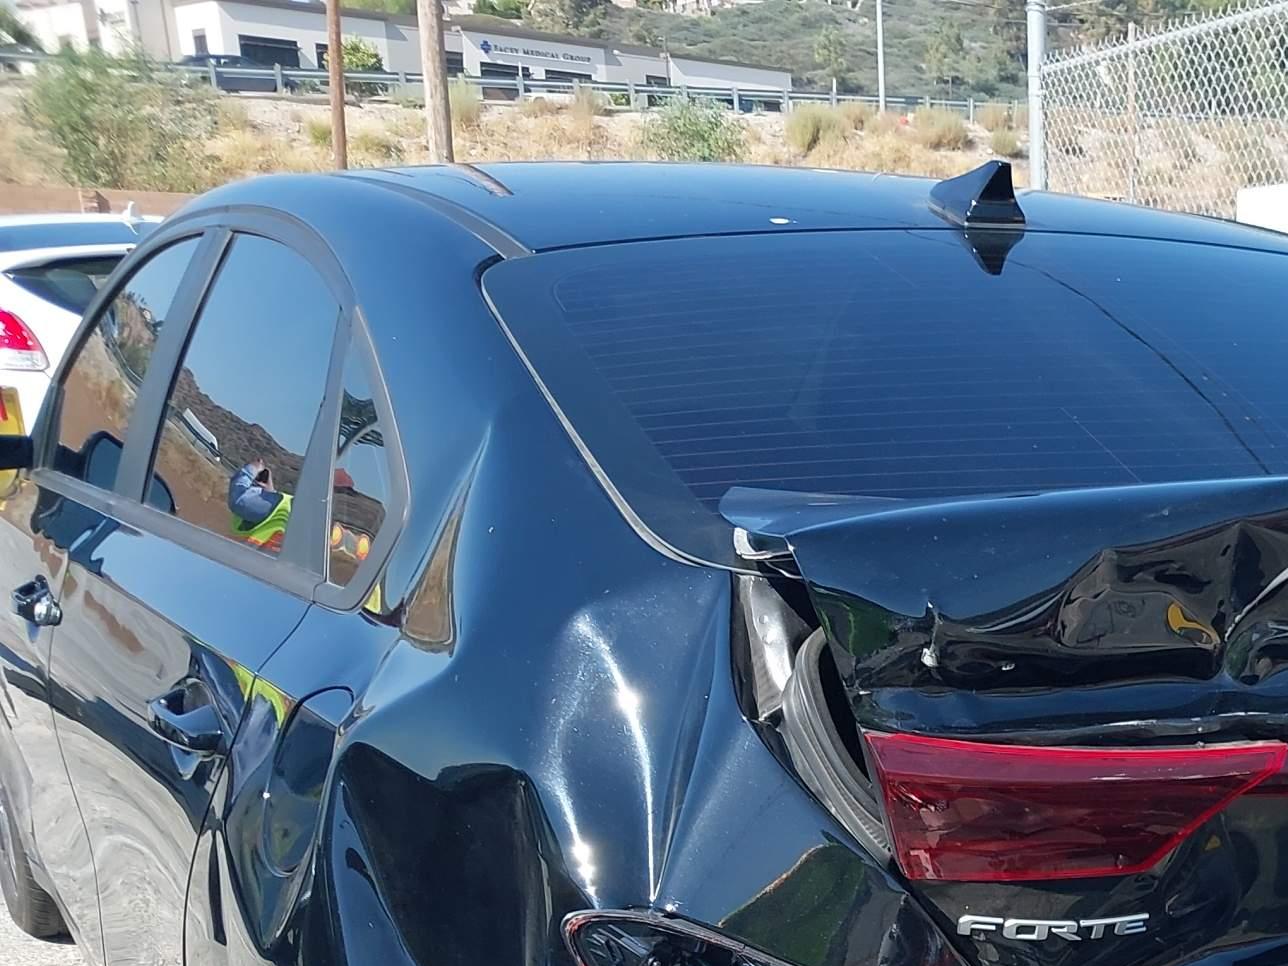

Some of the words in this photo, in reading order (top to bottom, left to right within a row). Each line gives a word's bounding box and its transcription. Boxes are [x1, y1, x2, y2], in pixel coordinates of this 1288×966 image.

[522, 48, 559, 59] MEDICAL
[562, 52, 591, 63] GROUP
[957, 913, 1150, 941] FORTE
